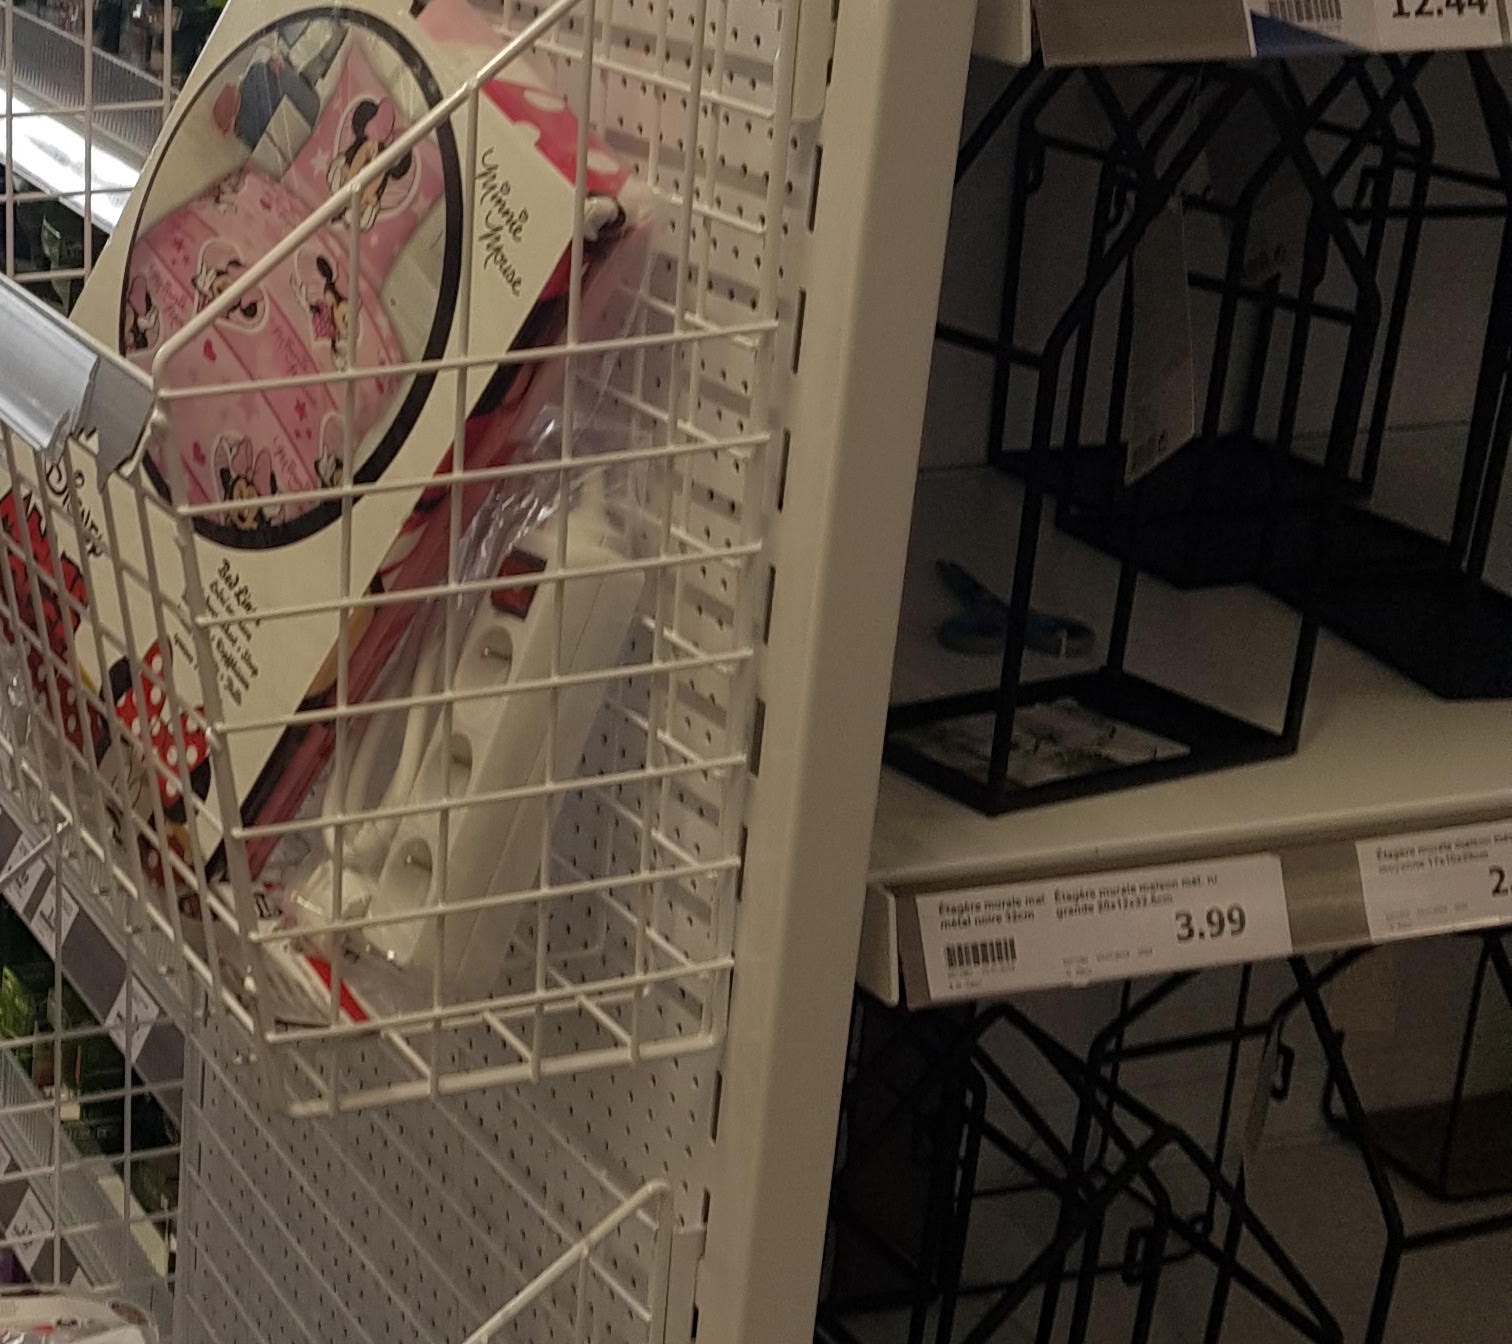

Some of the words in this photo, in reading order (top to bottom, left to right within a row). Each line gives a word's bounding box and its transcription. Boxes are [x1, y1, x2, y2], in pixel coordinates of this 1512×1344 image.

[475, 146, 530, 244] Minnie
[478, 211, 524, 297] Mouse
[217, 557, 240, 591] Bed
[984, 895, 1023, 912] murale
[1054, 886, 1097, 905] Étagère
[1099, 882, 1138, 899] murale
[1056, 902, 1095, 920] grande
[1175, 901, 1247, 943] 3.99
